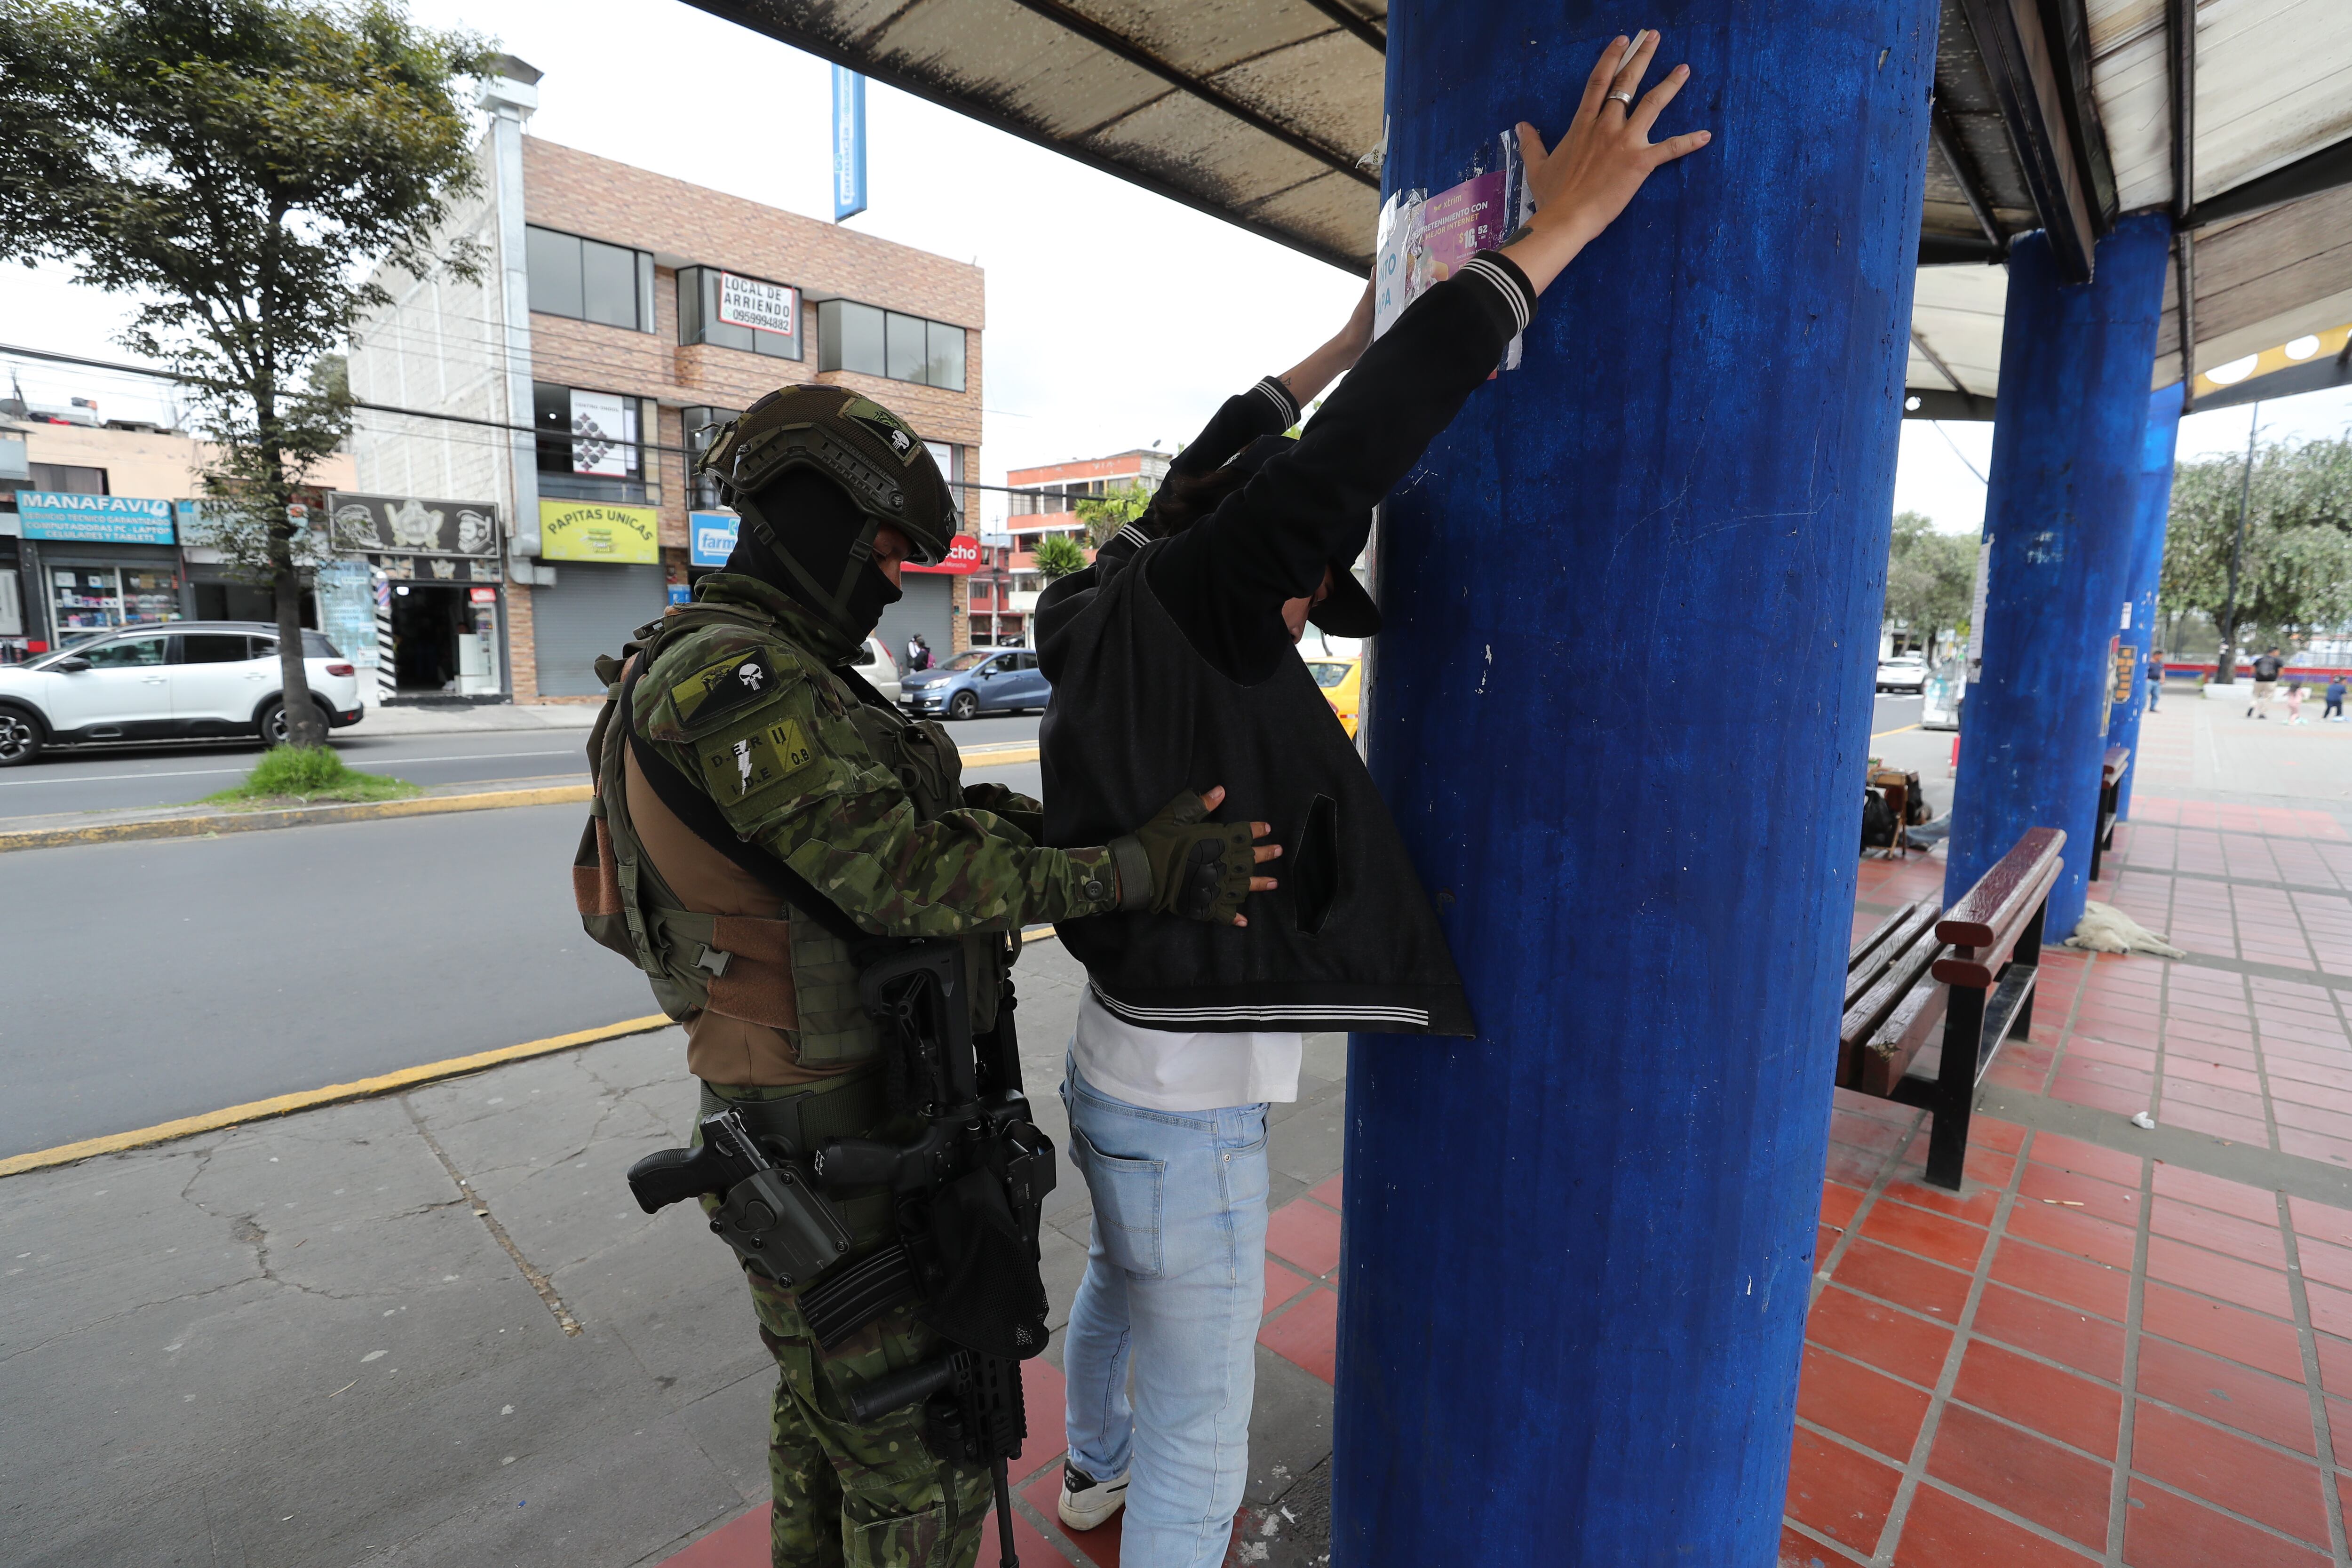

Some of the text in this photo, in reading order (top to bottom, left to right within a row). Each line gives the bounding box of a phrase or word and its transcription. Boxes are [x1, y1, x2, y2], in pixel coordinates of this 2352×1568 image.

[1443, 194, 1462, 209] xtrim
[1471, 201, 1488, 213] CON
[1425, 227, 1446, 240] MEJOR
[1447, 213, 1480, 231] INTERNET
[725, 276, 781, 301] LOCAL DE
[724, 292, 790, 318] ARRIENDO
[733, 309, 789, 331] 0959994882
[24, 512, 66, 521] SERVICIO
[107, 516, 170, 526] GARANTIZADO
[548, 508, 653, 541] PAPITAS UNICAS
[25, 522, 113, 532] COMPUTADORAS
[132, 526, 171, 534] LAPTOP
[45, 530, 103, 540] CELULARES
[113, 533, 155, 542] TABLETS
[946, 544, 977, 560] cho
